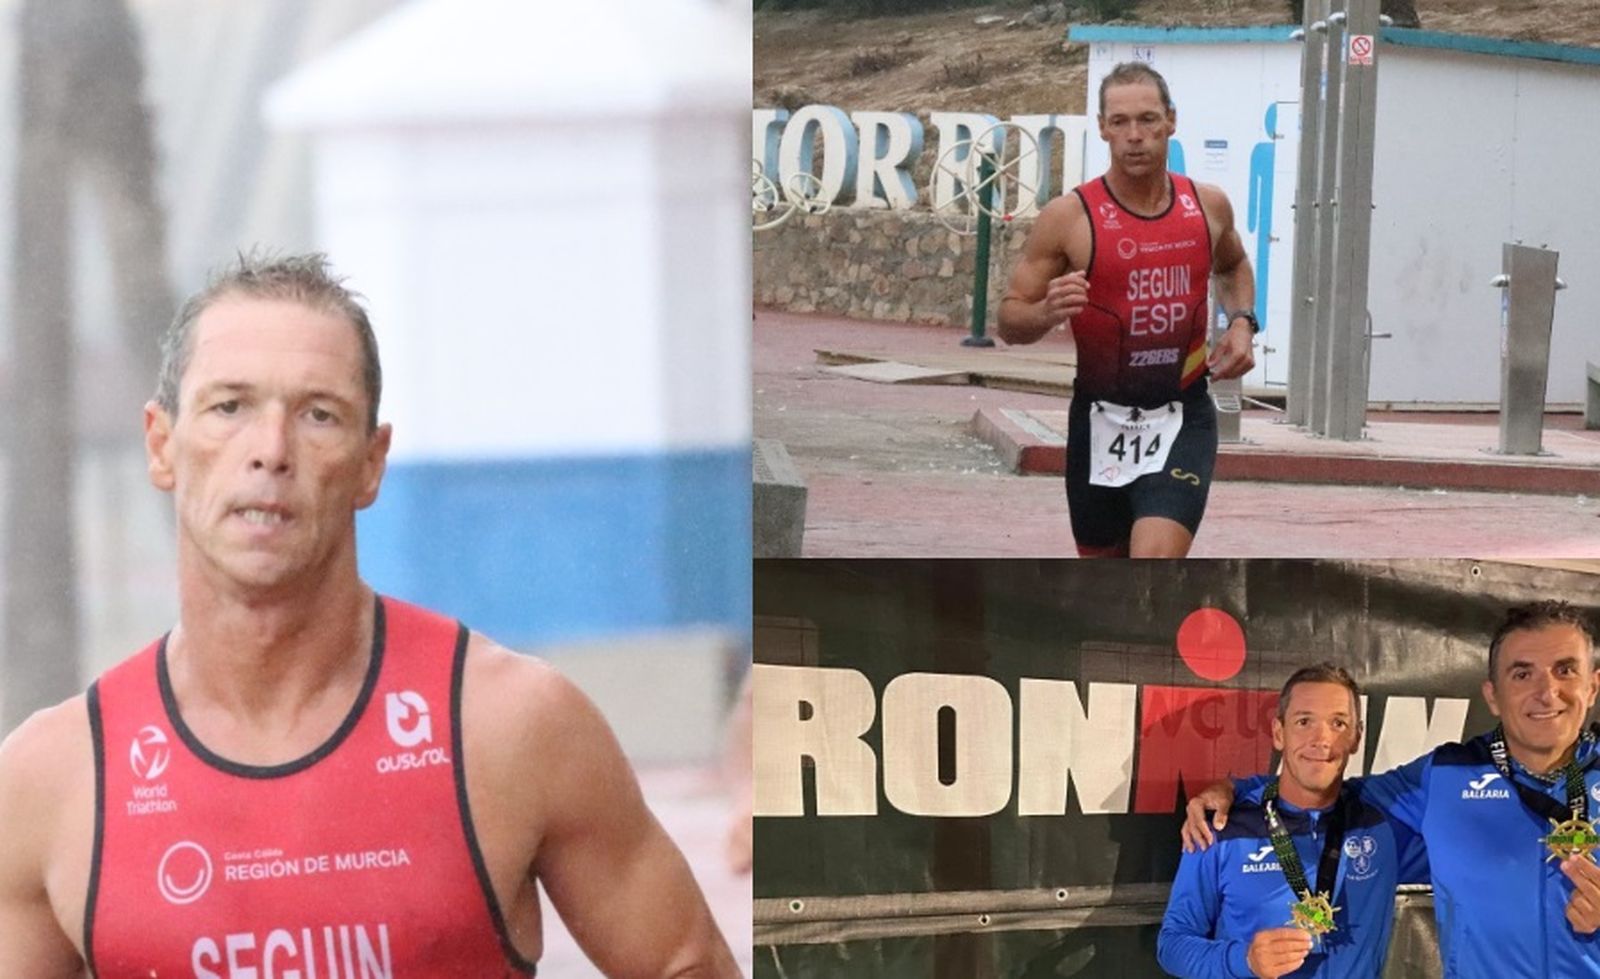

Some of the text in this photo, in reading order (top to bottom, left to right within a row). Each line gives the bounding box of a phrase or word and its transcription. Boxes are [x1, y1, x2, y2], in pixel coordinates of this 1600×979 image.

[1127, 265, 1191, 301] SEGUIN
[1130, 302, 1187, 336] ESP
[1108, 432, 1162, 464] 414
[126, 799, 178, 816] Triathlon
[132, 784, 168, 799] World
[225, 848, 411, 882] REGIÓN DE MURCIA
